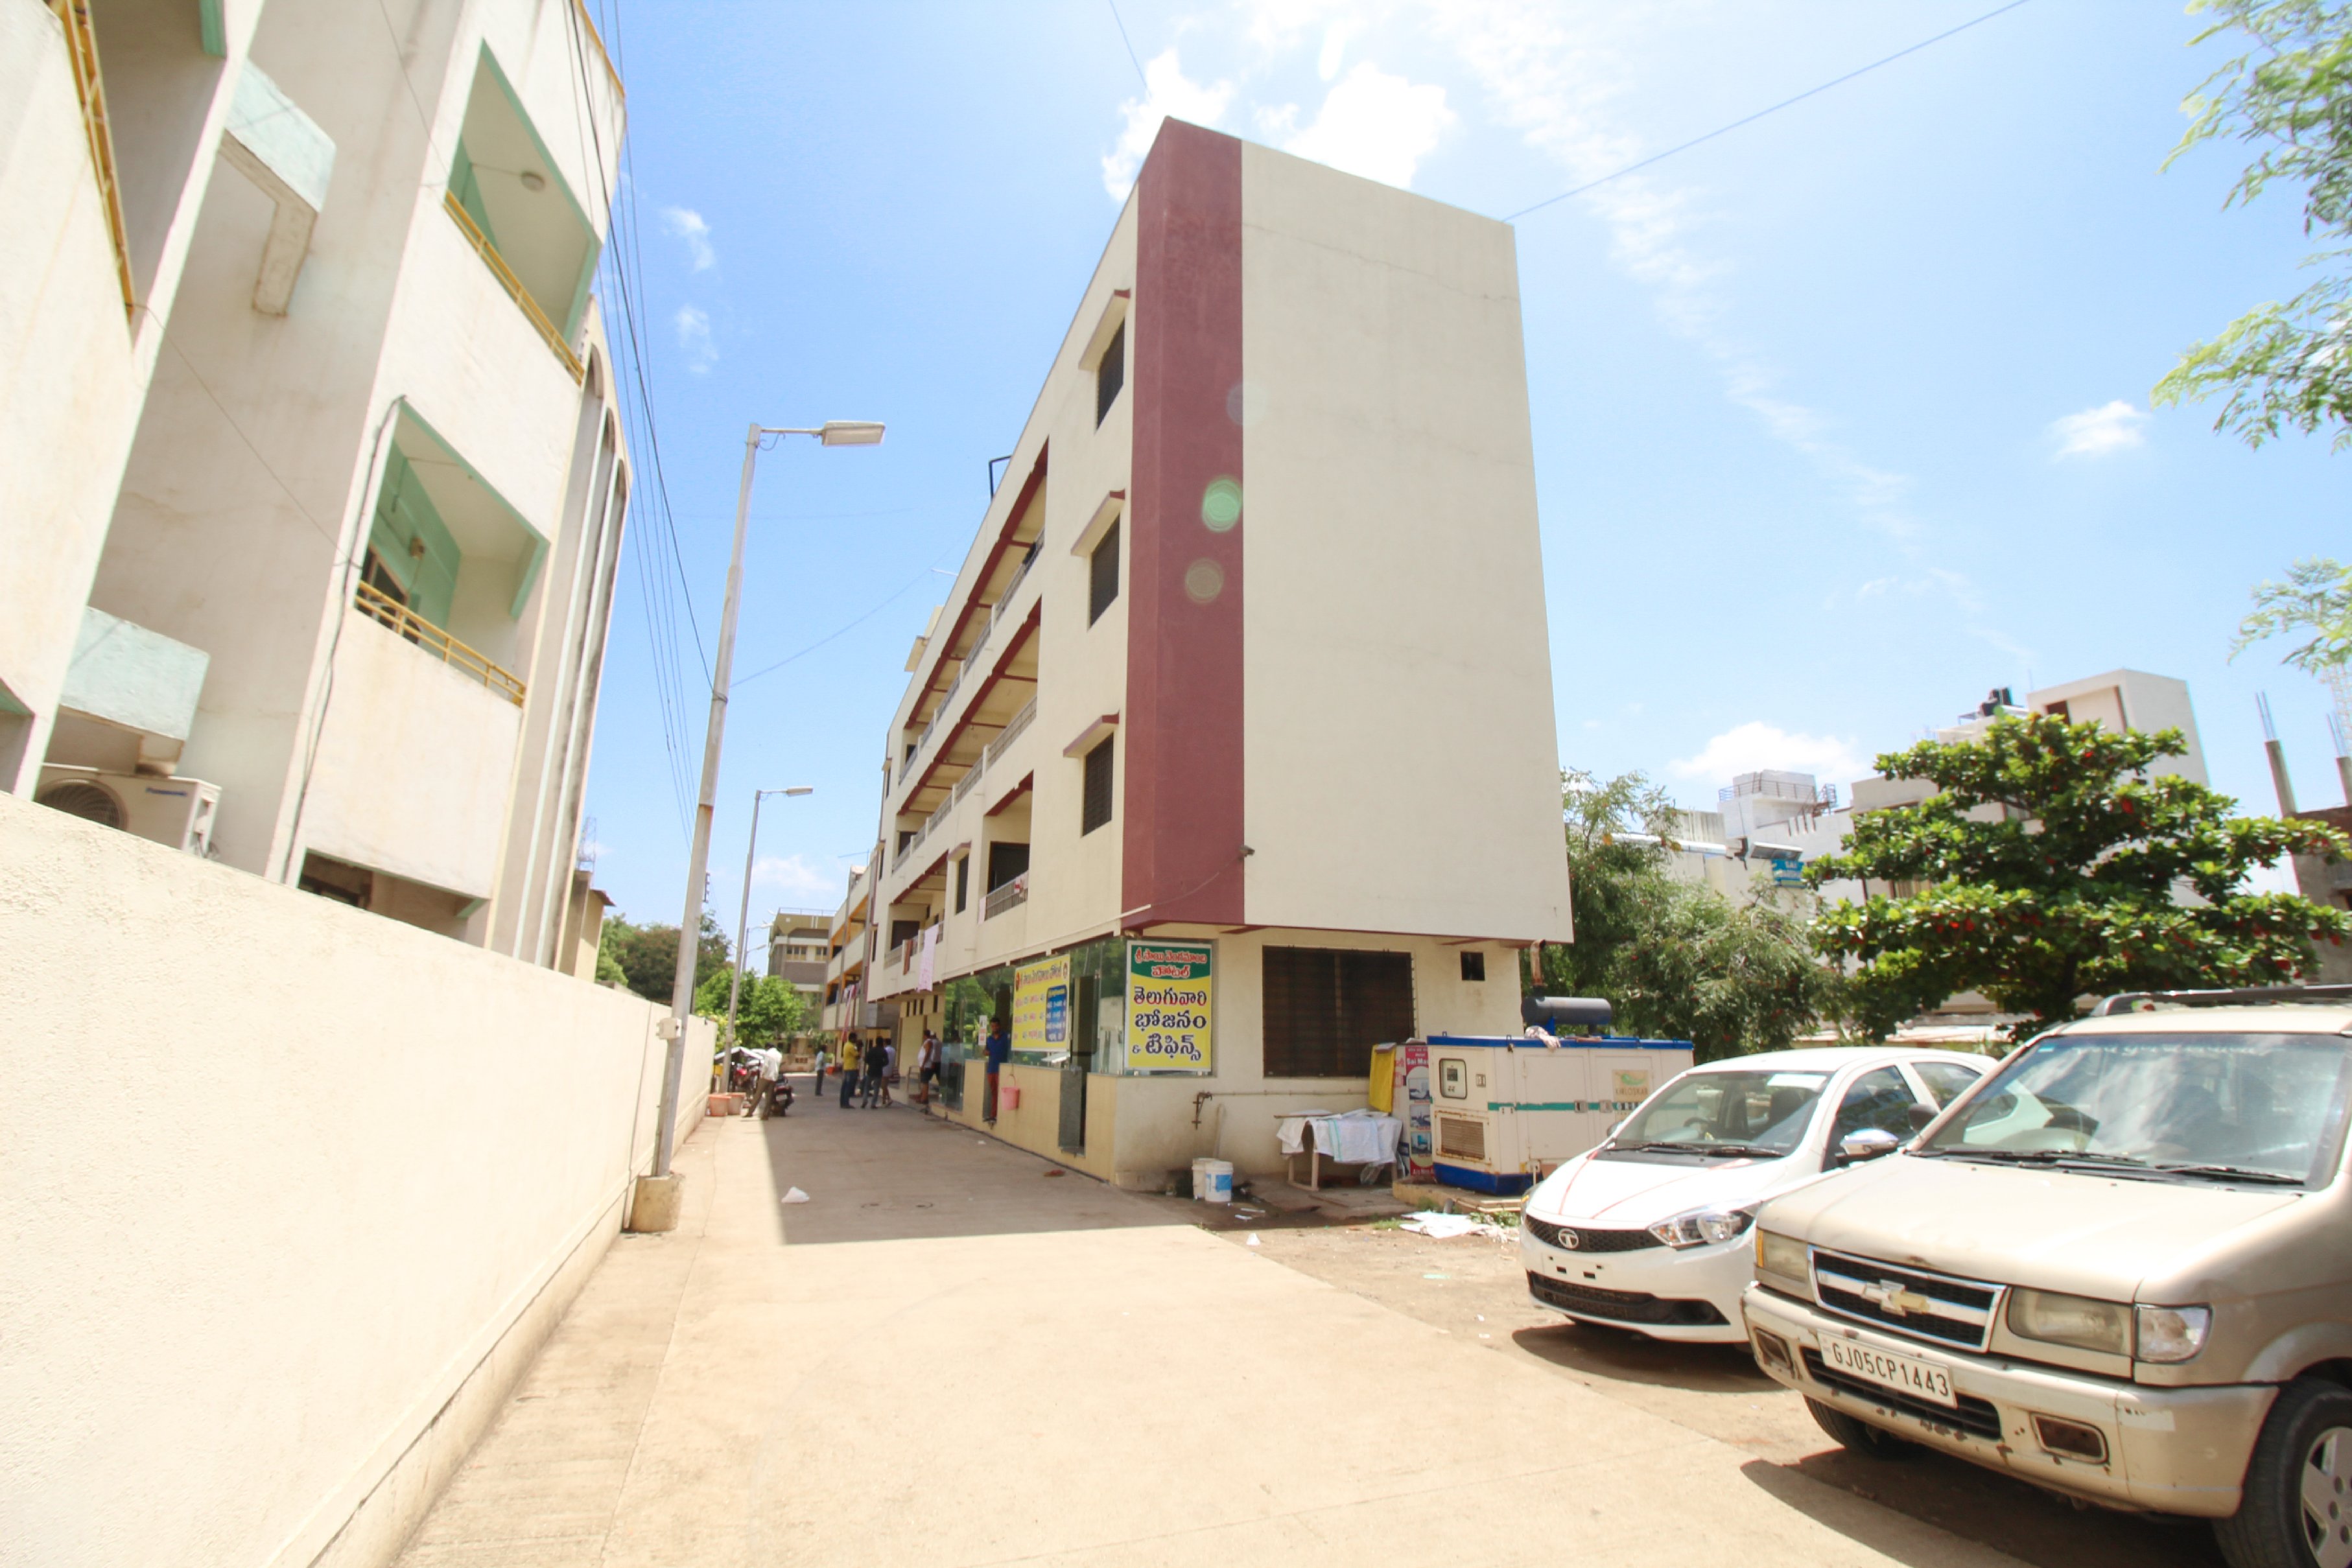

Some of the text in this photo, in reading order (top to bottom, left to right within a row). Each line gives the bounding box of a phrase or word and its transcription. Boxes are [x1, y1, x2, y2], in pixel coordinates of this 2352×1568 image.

[1134, 986, 1206, 1007] తెలుగువారి
[1135, 1009, 1206, 1031] భోజనం
[1133, 1044, 1141, 1054] &
[1832, 1342, 1948, 1397] GJ05CP1443
